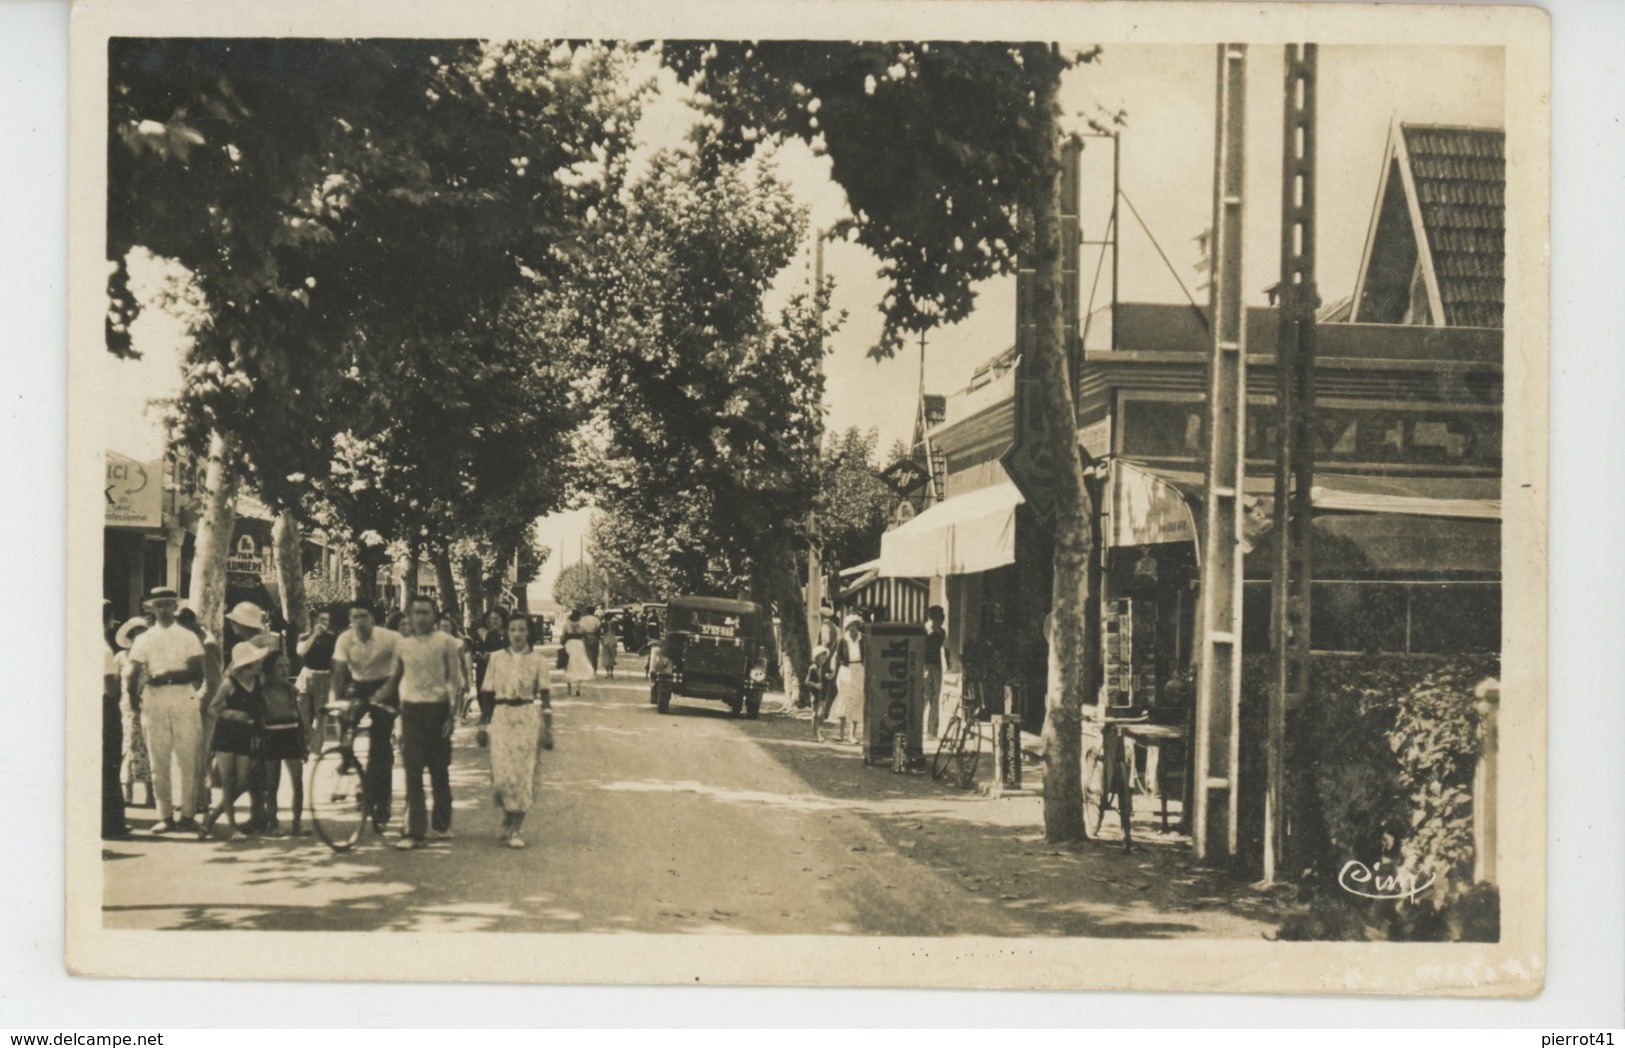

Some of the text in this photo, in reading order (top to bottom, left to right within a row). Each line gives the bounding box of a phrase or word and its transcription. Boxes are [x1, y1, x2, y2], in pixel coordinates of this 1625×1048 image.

[106, 464, 128, 480] ICI
[237, 552, 254, 560] FILM
[879, 637, 908, 744] Kodak
